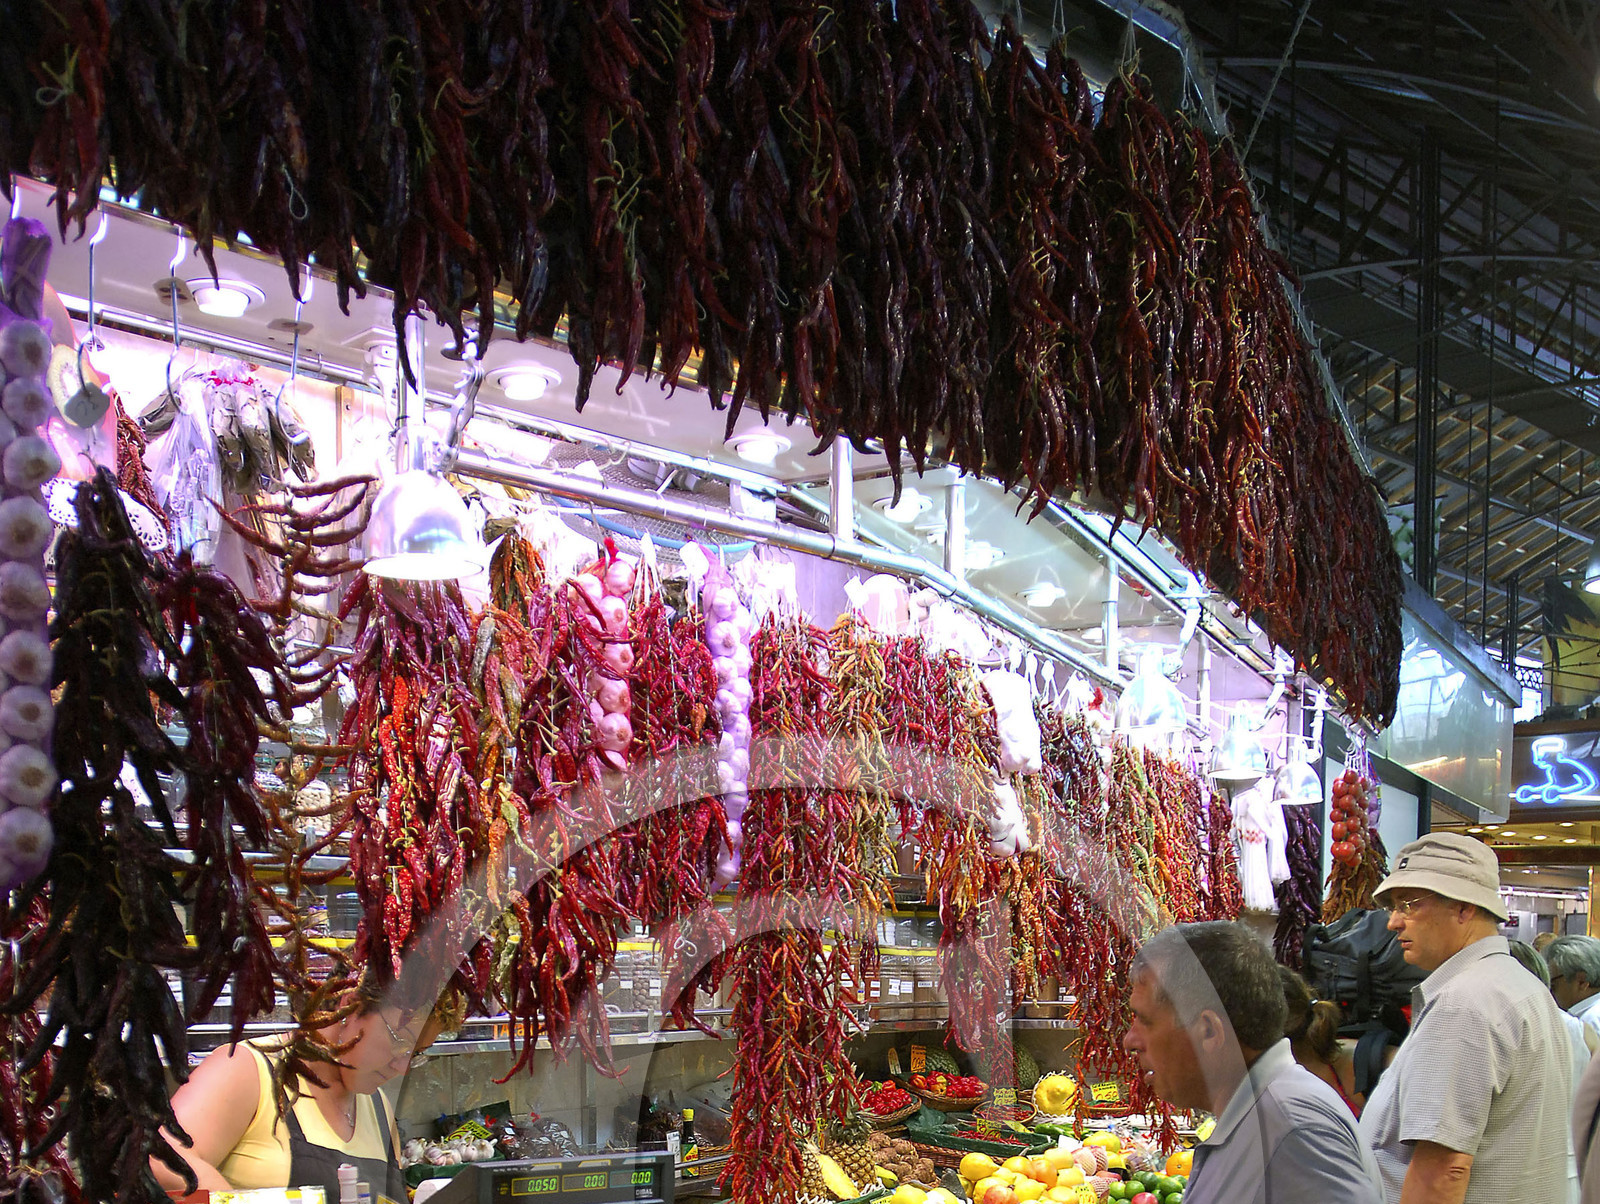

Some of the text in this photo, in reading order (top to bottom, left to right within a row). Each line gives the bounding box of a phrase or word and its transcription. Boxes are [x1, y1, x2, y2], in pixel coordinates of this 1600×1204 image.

[584, 1175, 605, 1188] 0.00
[631, 1171, 651, 1184] 0.00
[528, 1178, 557, 1192] 0.050
